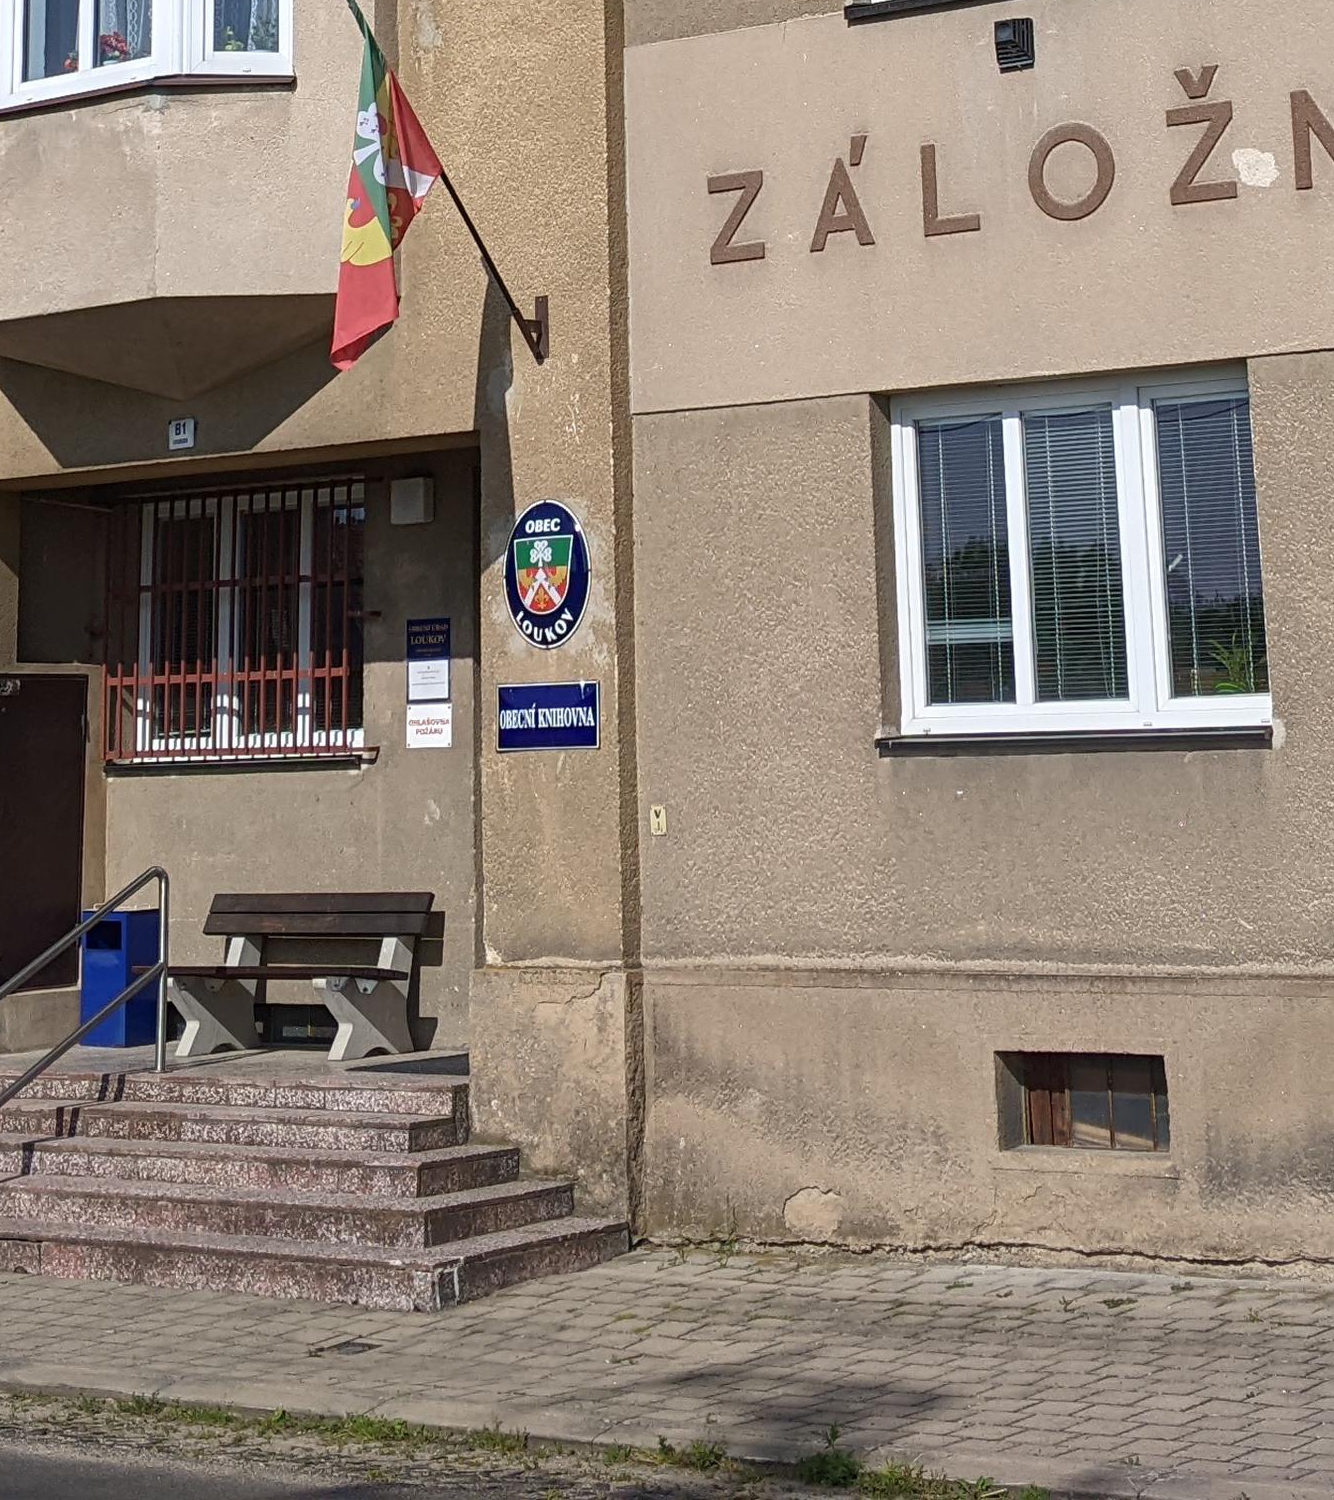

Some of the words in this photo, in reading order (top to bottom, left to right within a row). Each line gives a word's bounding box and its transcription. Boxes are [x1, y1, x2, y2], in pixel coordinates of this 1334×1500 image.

[174, 421, 186, 436] 81
[525, 518, 561, 533] OBEC
[516, 607, 574, 642] LOUKOV
[411, 634, 446, 645] LOUKOV
[500, 702, 536, 729] OBECNÍ
[538, 706, 595, 728] KNIHOVNA
